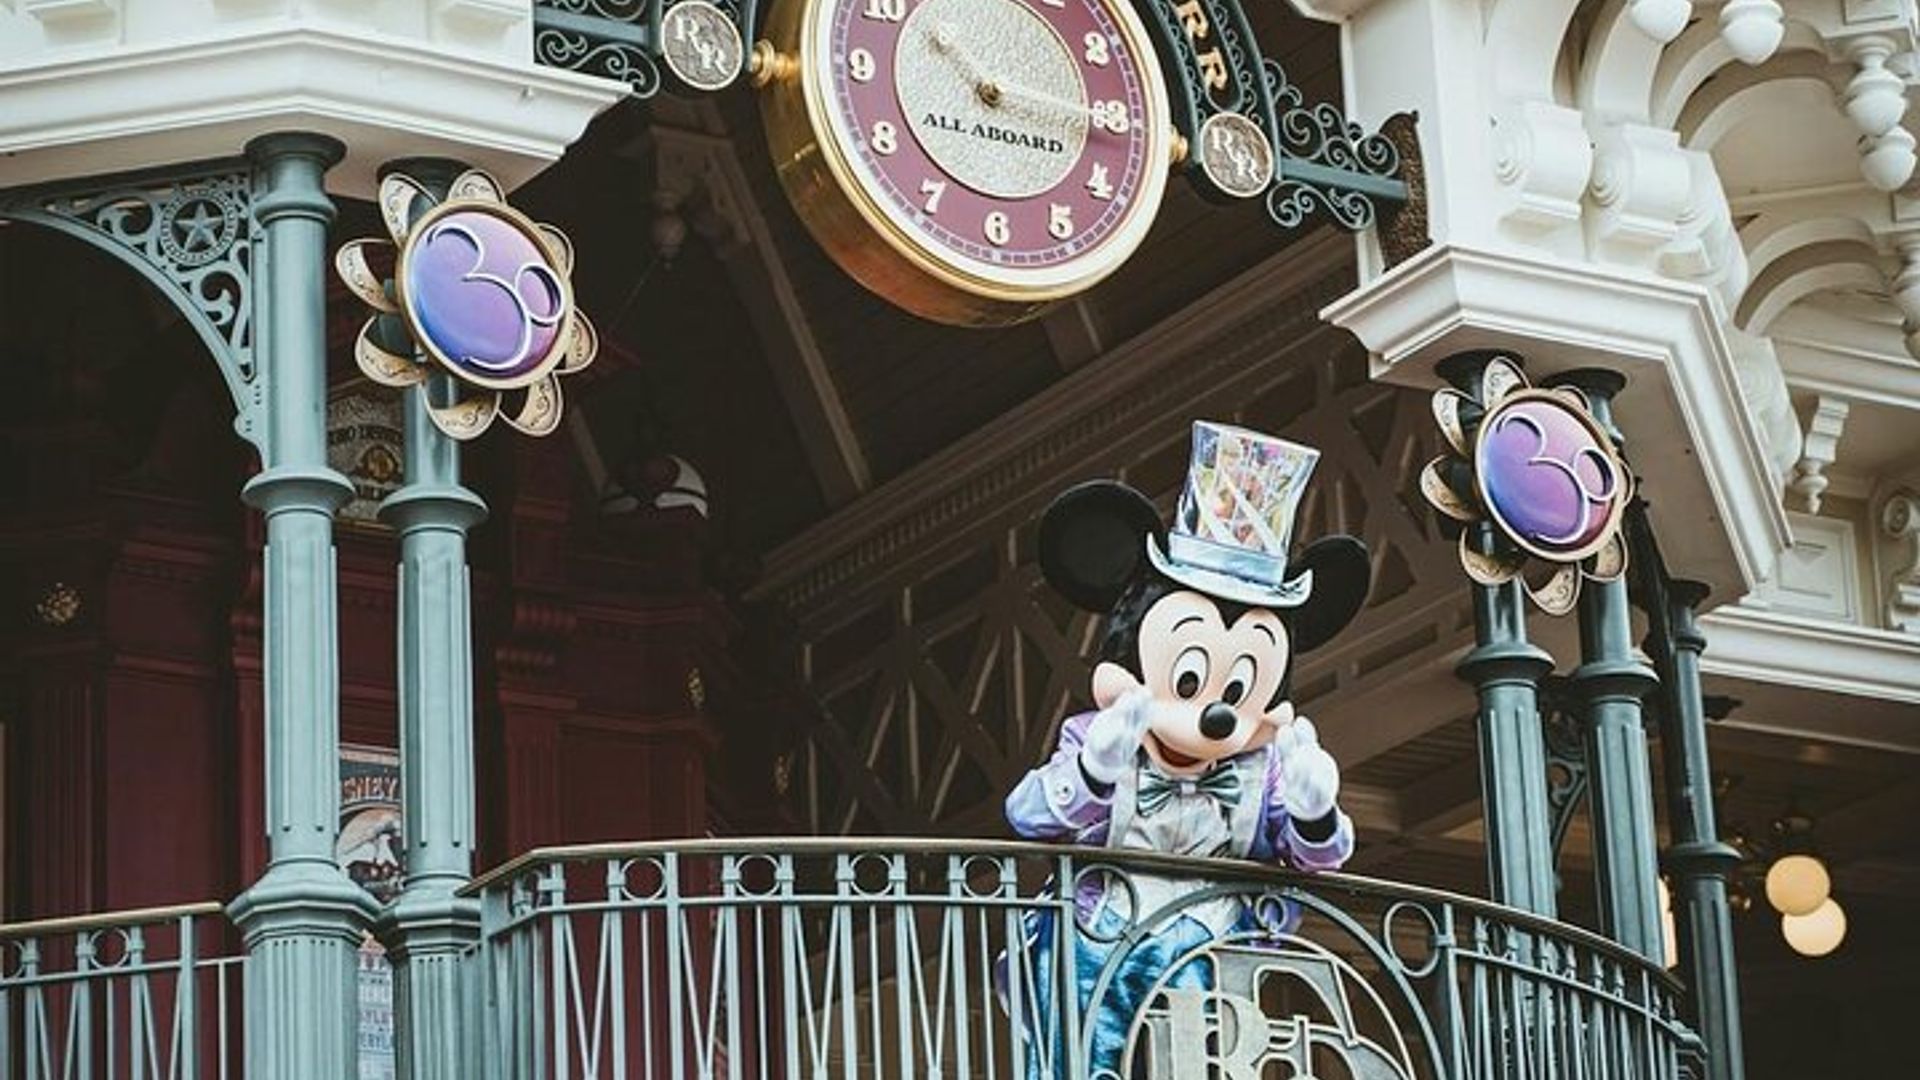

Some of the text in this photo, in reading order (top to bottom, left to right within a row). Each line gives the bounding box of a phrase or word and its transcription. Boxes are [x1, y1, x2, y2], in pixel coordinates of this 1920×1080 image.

[848, 47, 876, 83] 9
[1083, 30, 1110, 67] 2
[922, 111, 1065, 155] ALL ABOARD
[1101, 99, 1130, 134] 3
[870, 120, 898, 156] 8
[919, 178, 947, 216] 7
[1084, 162, 1114, 200] 4
[983, 210, 1011, 245] 6
[1048, 202, 1075, 240] 5
[425, 221, 566, 371] 30
[1496, 411, 1618, 545] 30
